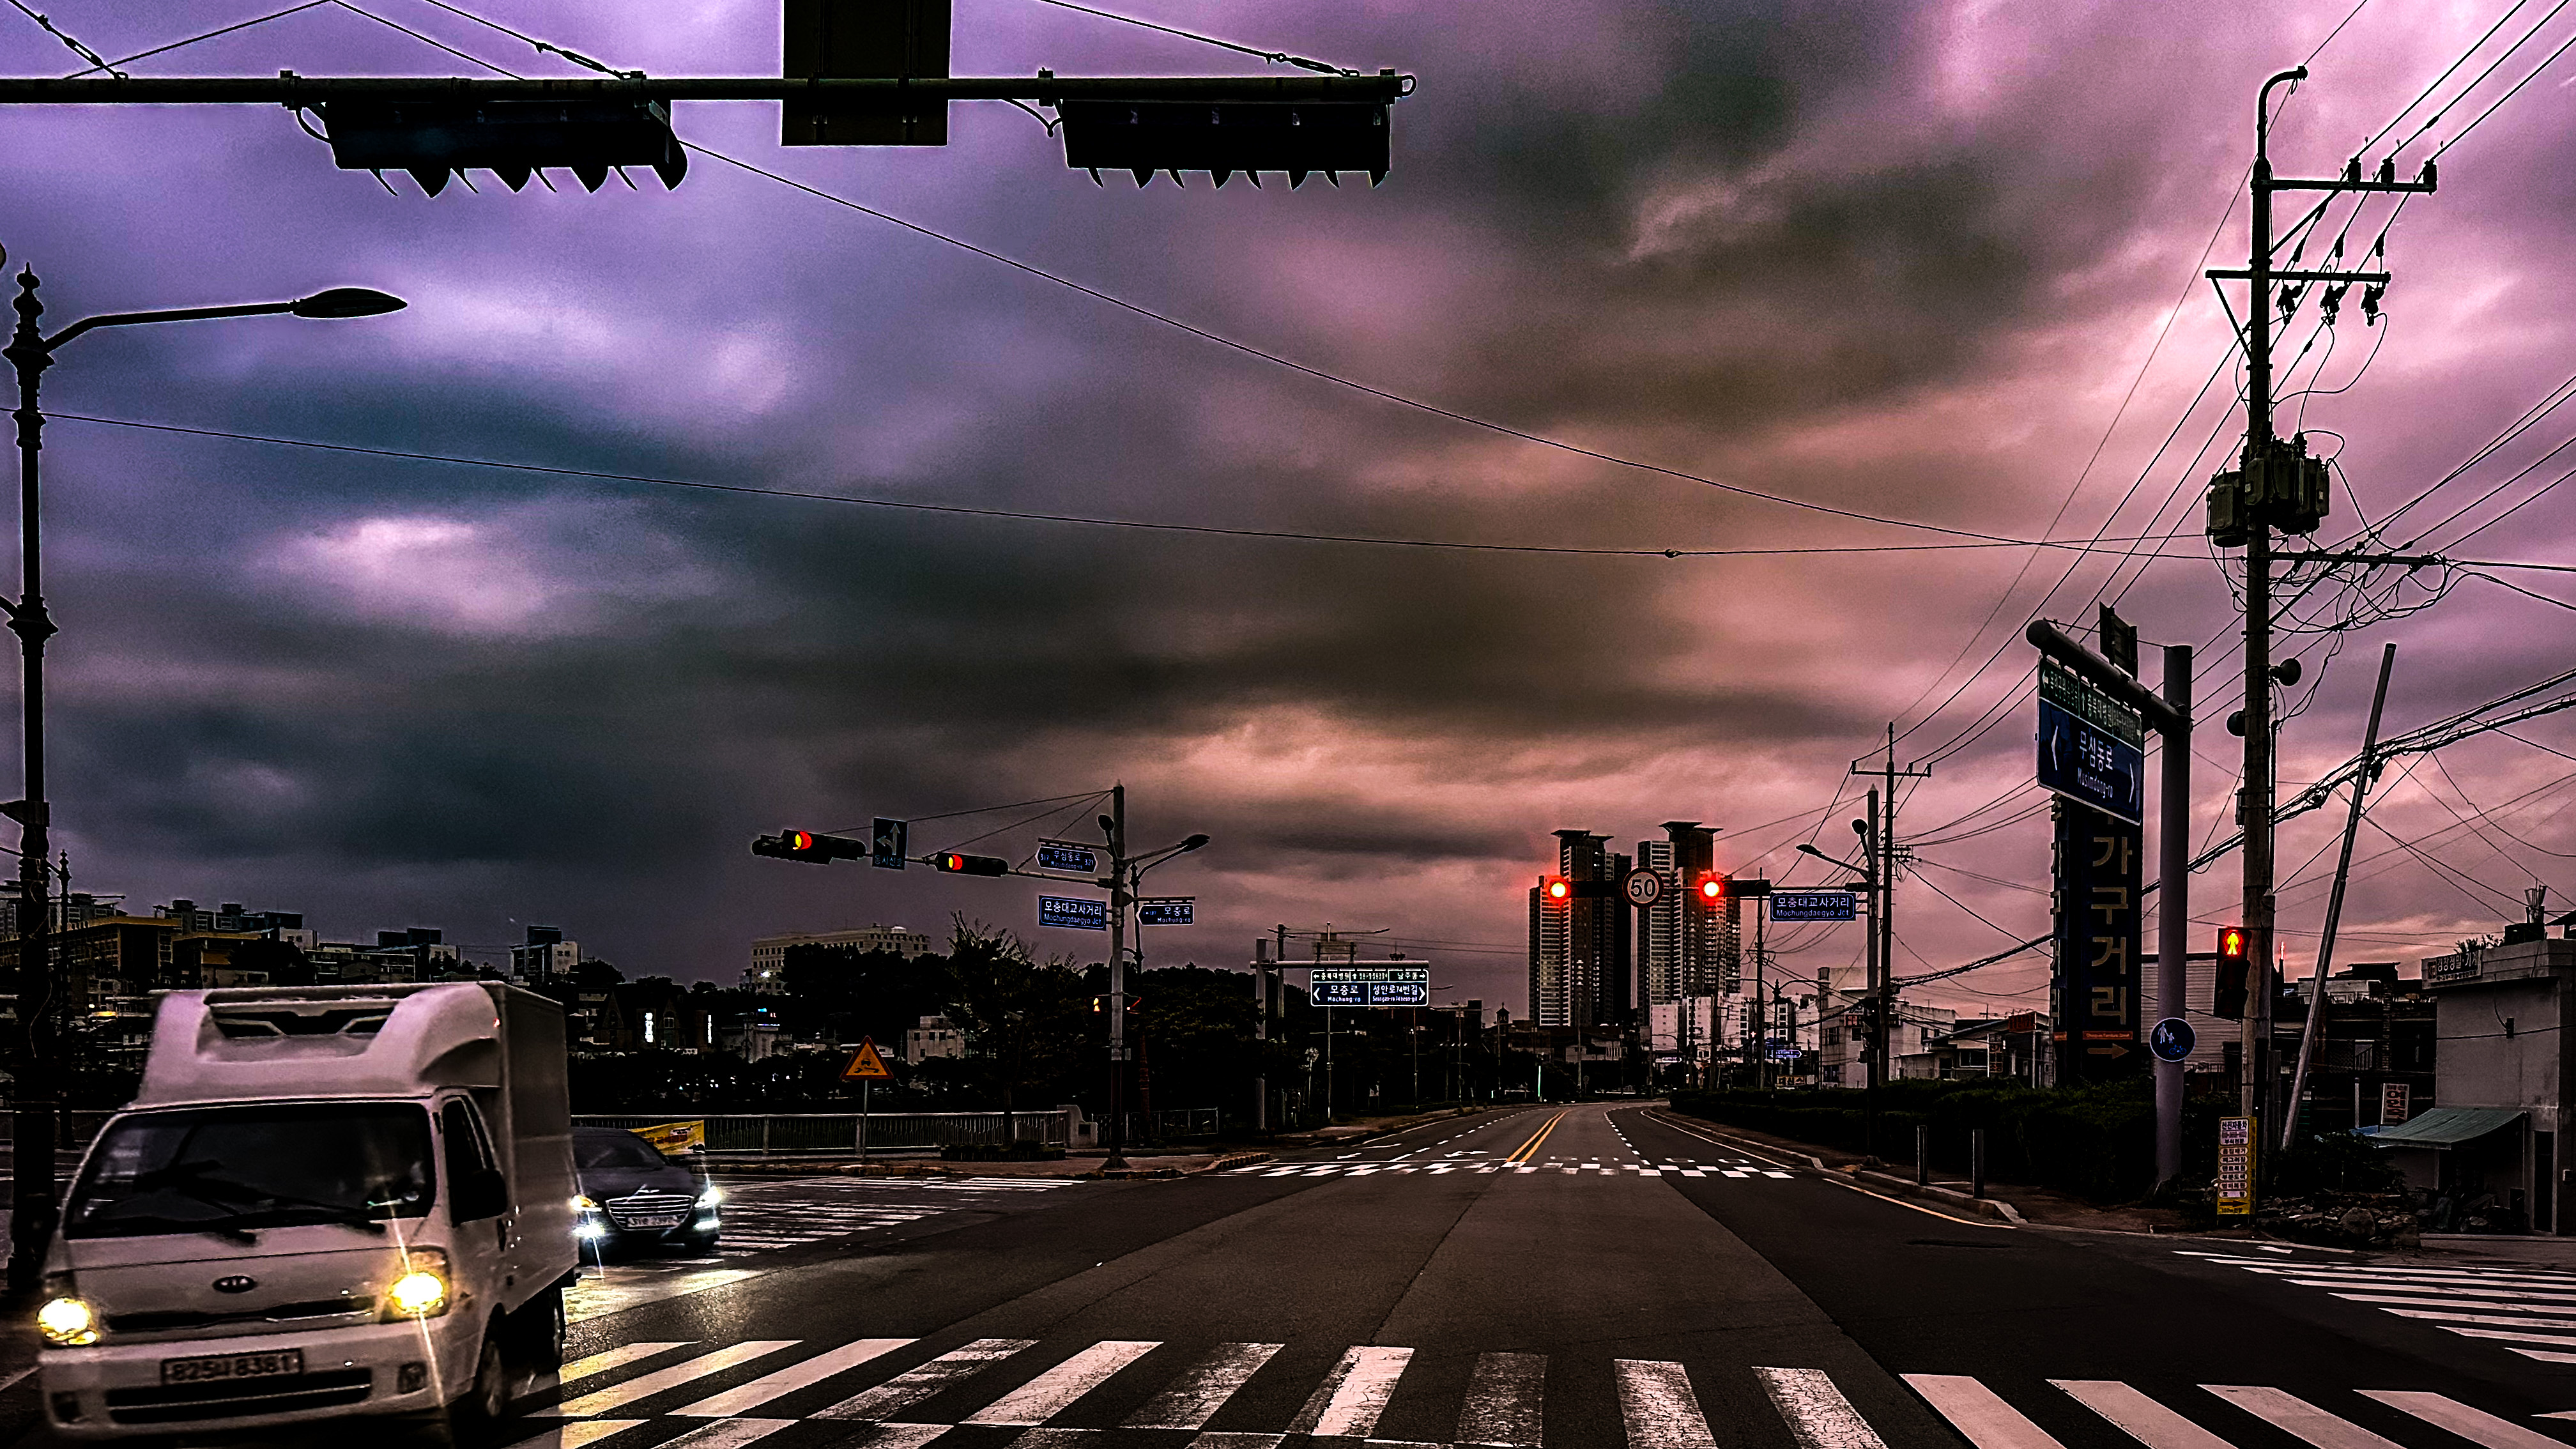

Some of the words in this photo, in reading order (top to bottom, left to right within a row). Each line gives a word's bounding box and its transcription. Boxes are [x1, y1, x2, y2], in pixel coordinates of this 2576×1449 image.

[2087, 693, 2112, 727] 충북대병원
[2080, 731, 2113, 772] 무심동로
[2078, 767, 2113, 799] Musimdong-ro
[875, 855, 902, 866] 동시신호
[1054, 850, 1080, 862] 무심동로
[1630, 878, 1655, 897] 50
[1045, 901, 1101, 916] 모충대교사거리
[1777, 897, 1849, 908] 모충대교사거리
[1164, 907, 1190, 916] 모충로
[1776, 909, 1834, 917] Mochungdaegyo
[1044, 913, 1091, 925] Mochungdaegyo
[1330, 985, 1359, 995] 모충로
[1373, 985, 1417, 995] 성안로74번길
